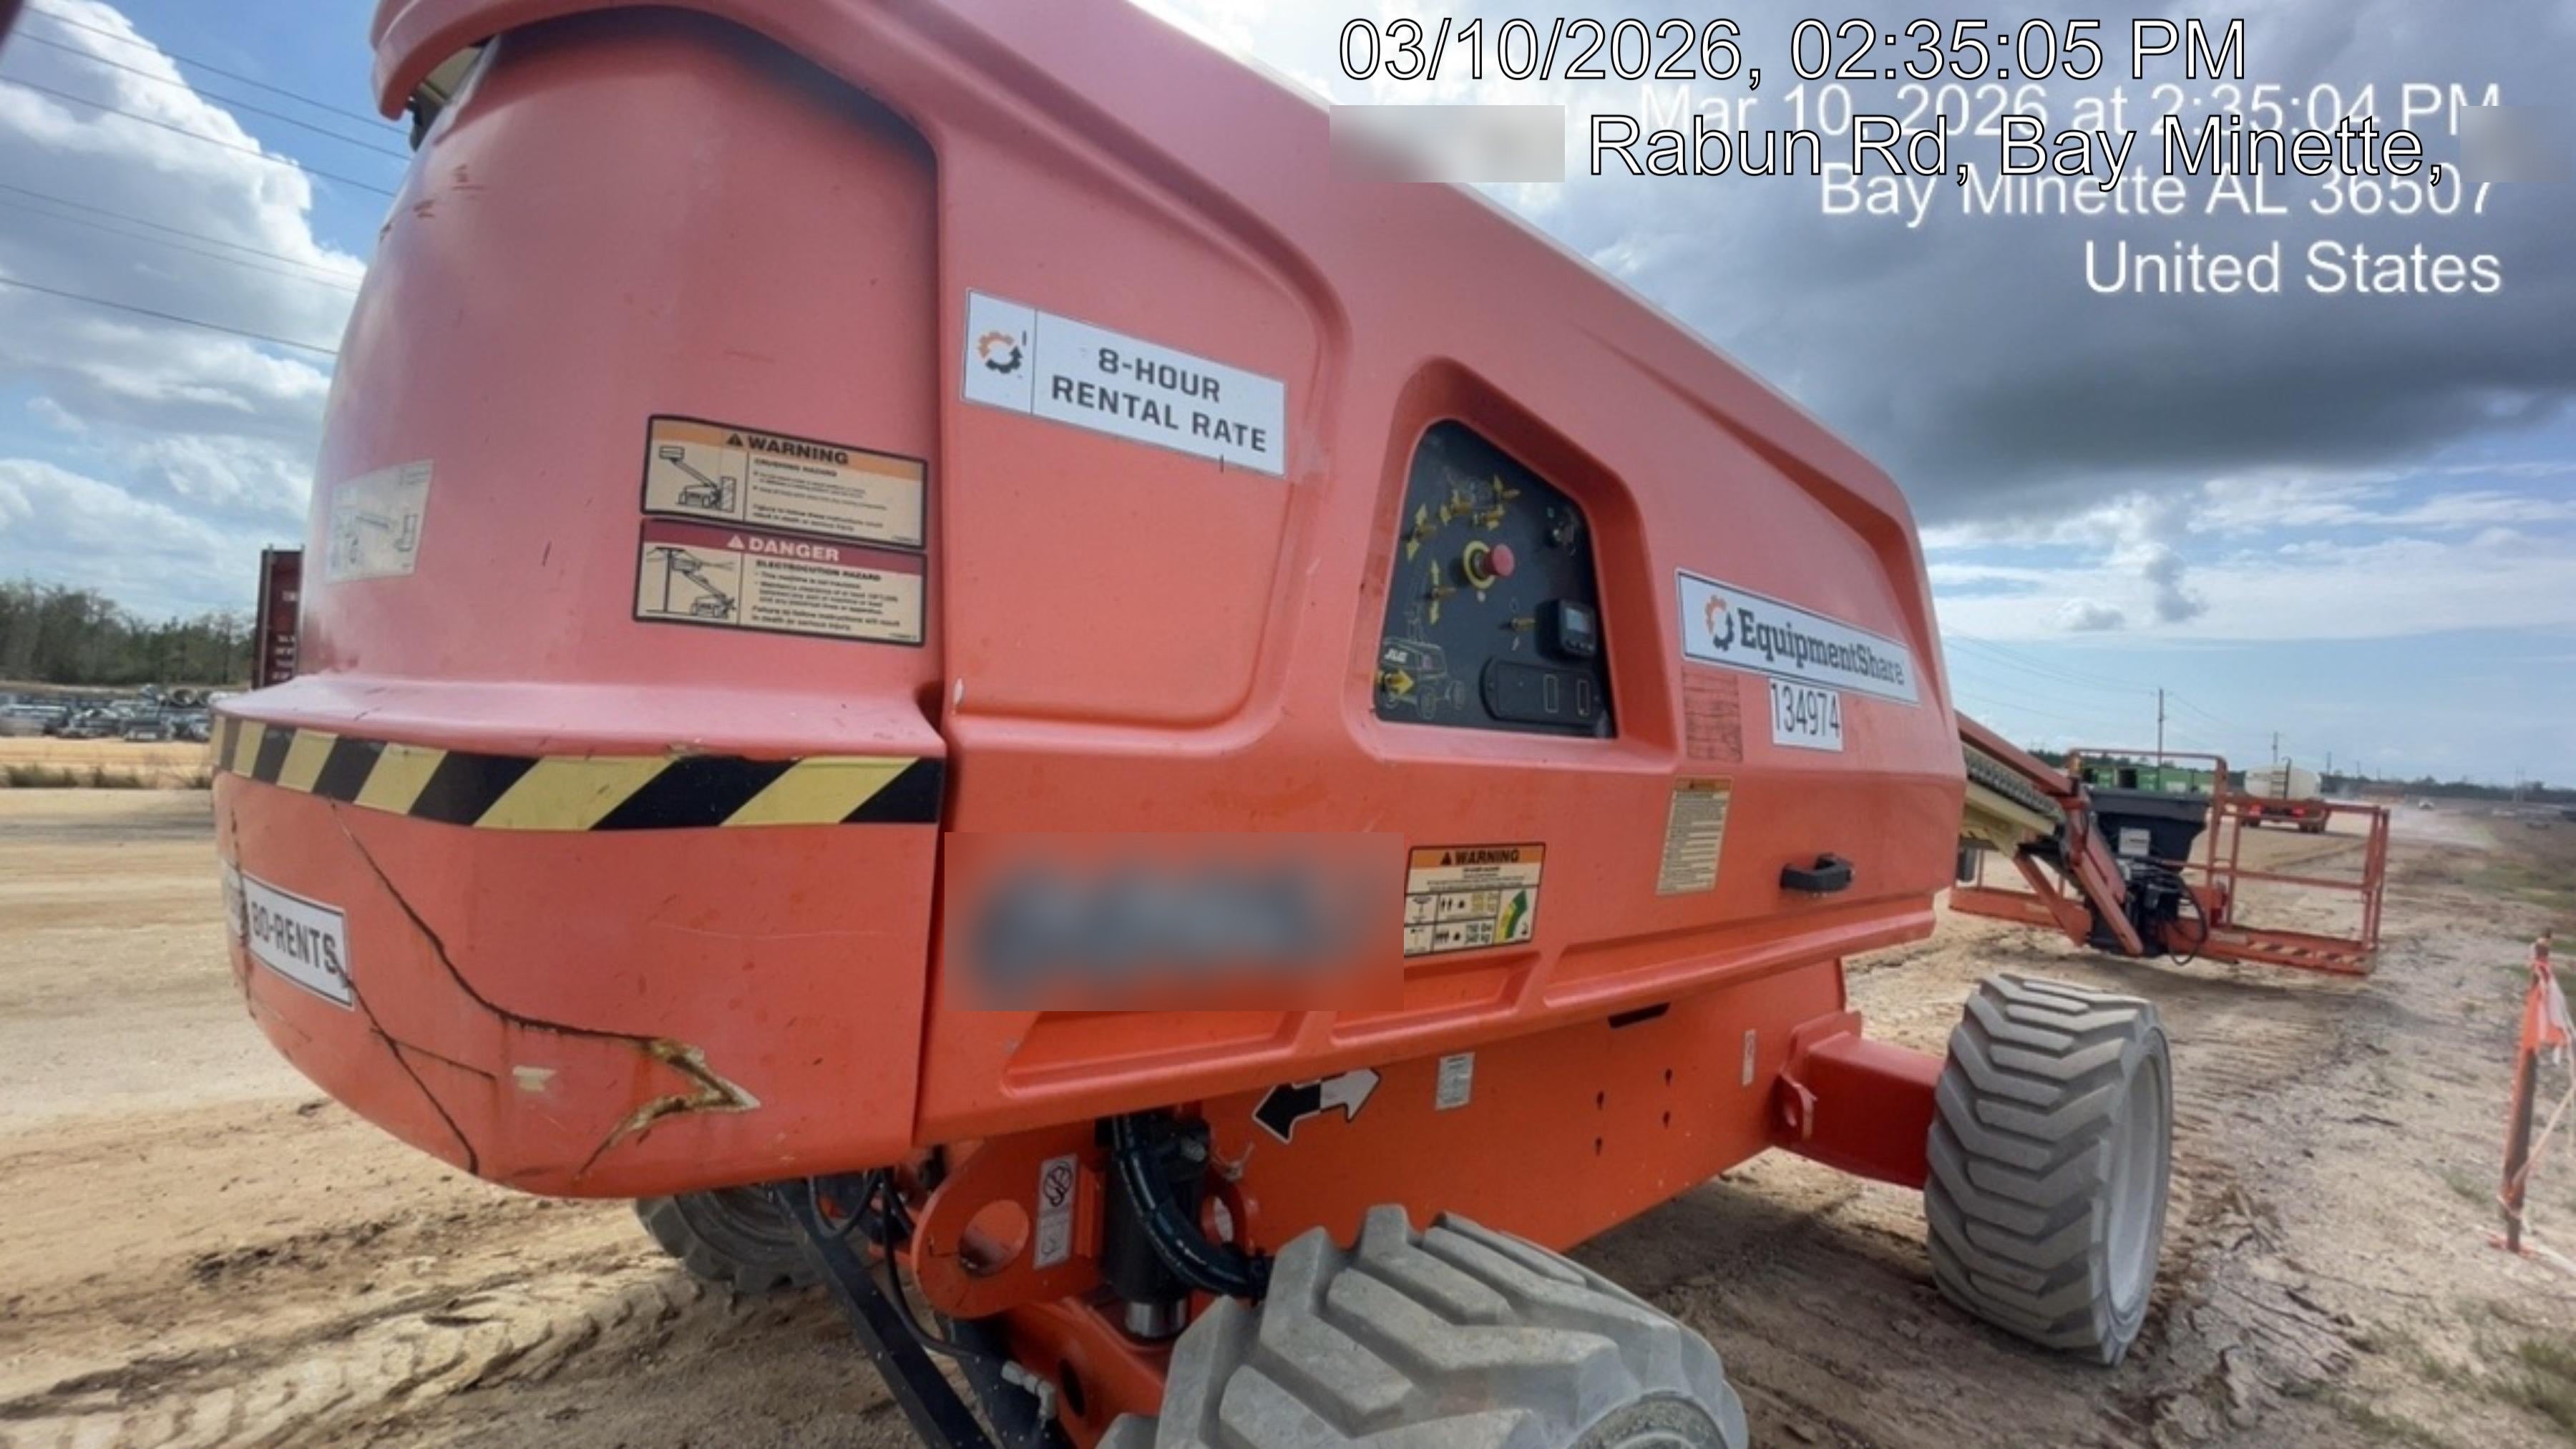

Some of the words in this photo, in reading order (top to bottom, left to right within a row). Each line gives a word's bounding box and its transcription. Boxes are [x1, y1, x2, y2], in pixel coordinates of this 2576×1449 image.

[1098, 347, 1221, 403] 8-HOUR
[1052, 374, 1179, 430] RENTAL
[1192, 411, 1267, 452] RATE
[747, 436, 849, 466] WARNING
[748, 537, 841, 562] DANGER
[1737, 606, 1904, 686] EquipmentShare
[1771, 682, 1840, 739] 134974
[1455, 849, 1520, 865] WARNING
